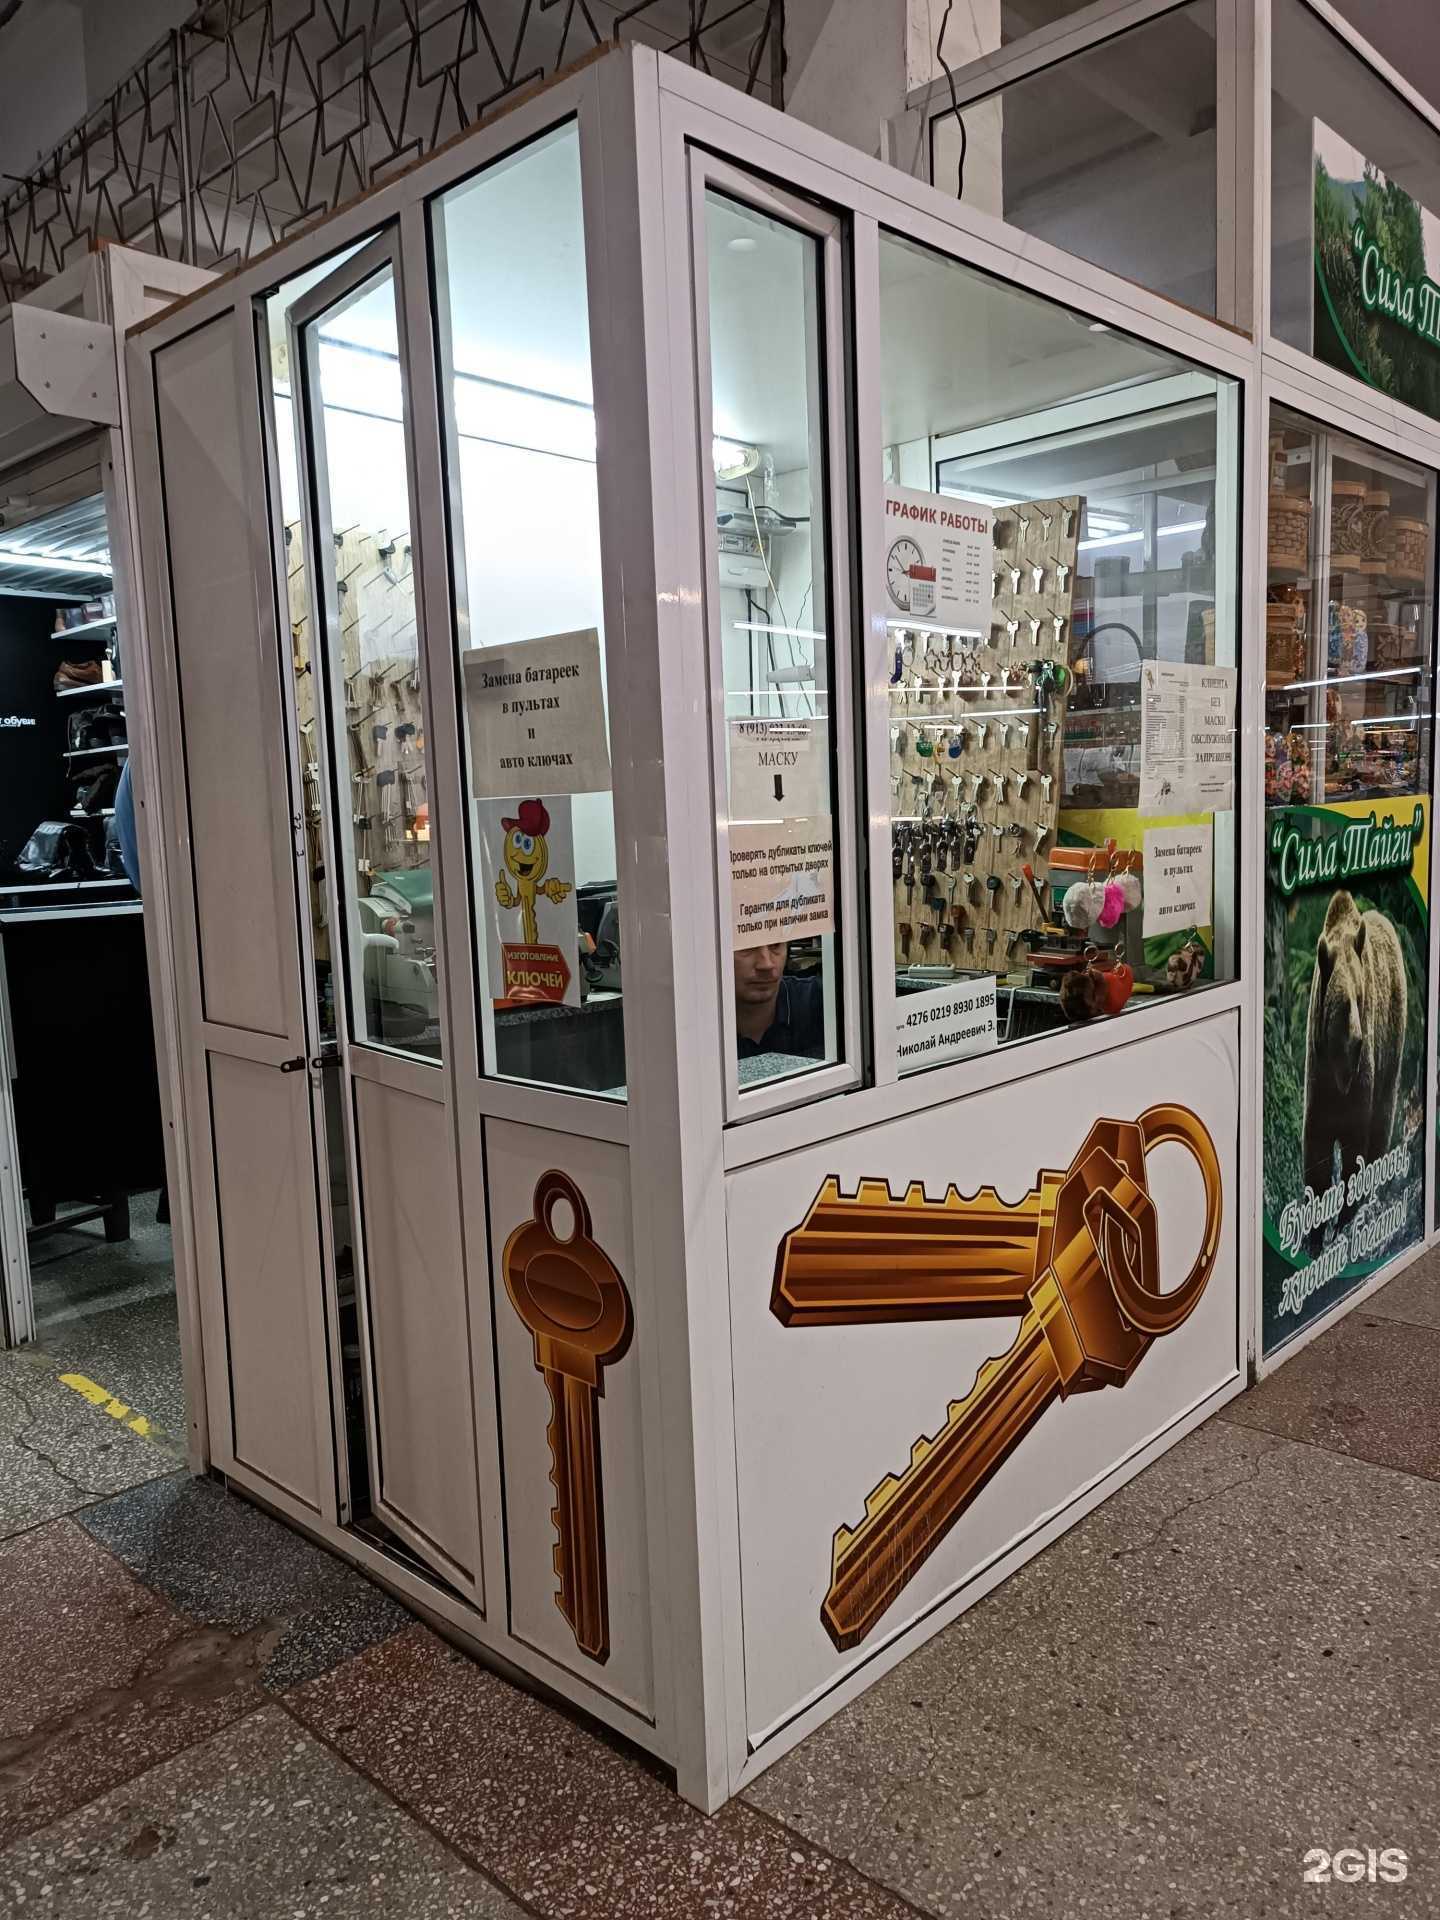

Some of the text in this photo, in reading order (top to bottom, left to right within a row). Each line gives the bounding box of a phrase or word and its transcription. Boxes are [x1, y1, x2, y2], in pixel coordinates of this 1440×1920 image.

[886, 499, 988, 534] ГРАФИК РАБОТЫ
[481, 664, 580, 689] Замена батареек
[502, 696, 560, 716] в пультах
[1204, 715, 1226, 726] МАСКИ
[527, 728, 535, 740] и
[500, 753, 573, 769] авто ключах
[758, 751, 798, 767] МАСКУ
[768, 845, 807, 860] дубликаты
[1154, 844, 1202, 858] Замена батареек
[732, 859, 828, 880] только на открытых дверях
[1169, 865, 1193, 878] пультах
[740, 893, 826, 917] Гарантия для дубликата
[1159, 902, 1196, 915] авто ключах
[737, 909, 829, 934] только при наличии замка
[506, 970, 564, 989] КЛЮЧЕЙ
[906, 993, 995, 1028] 4276 0219 8930 1895
[938, 1024, 986, 1047] Андреевич
[1279, 1180, 1346, 1258] Будьте
